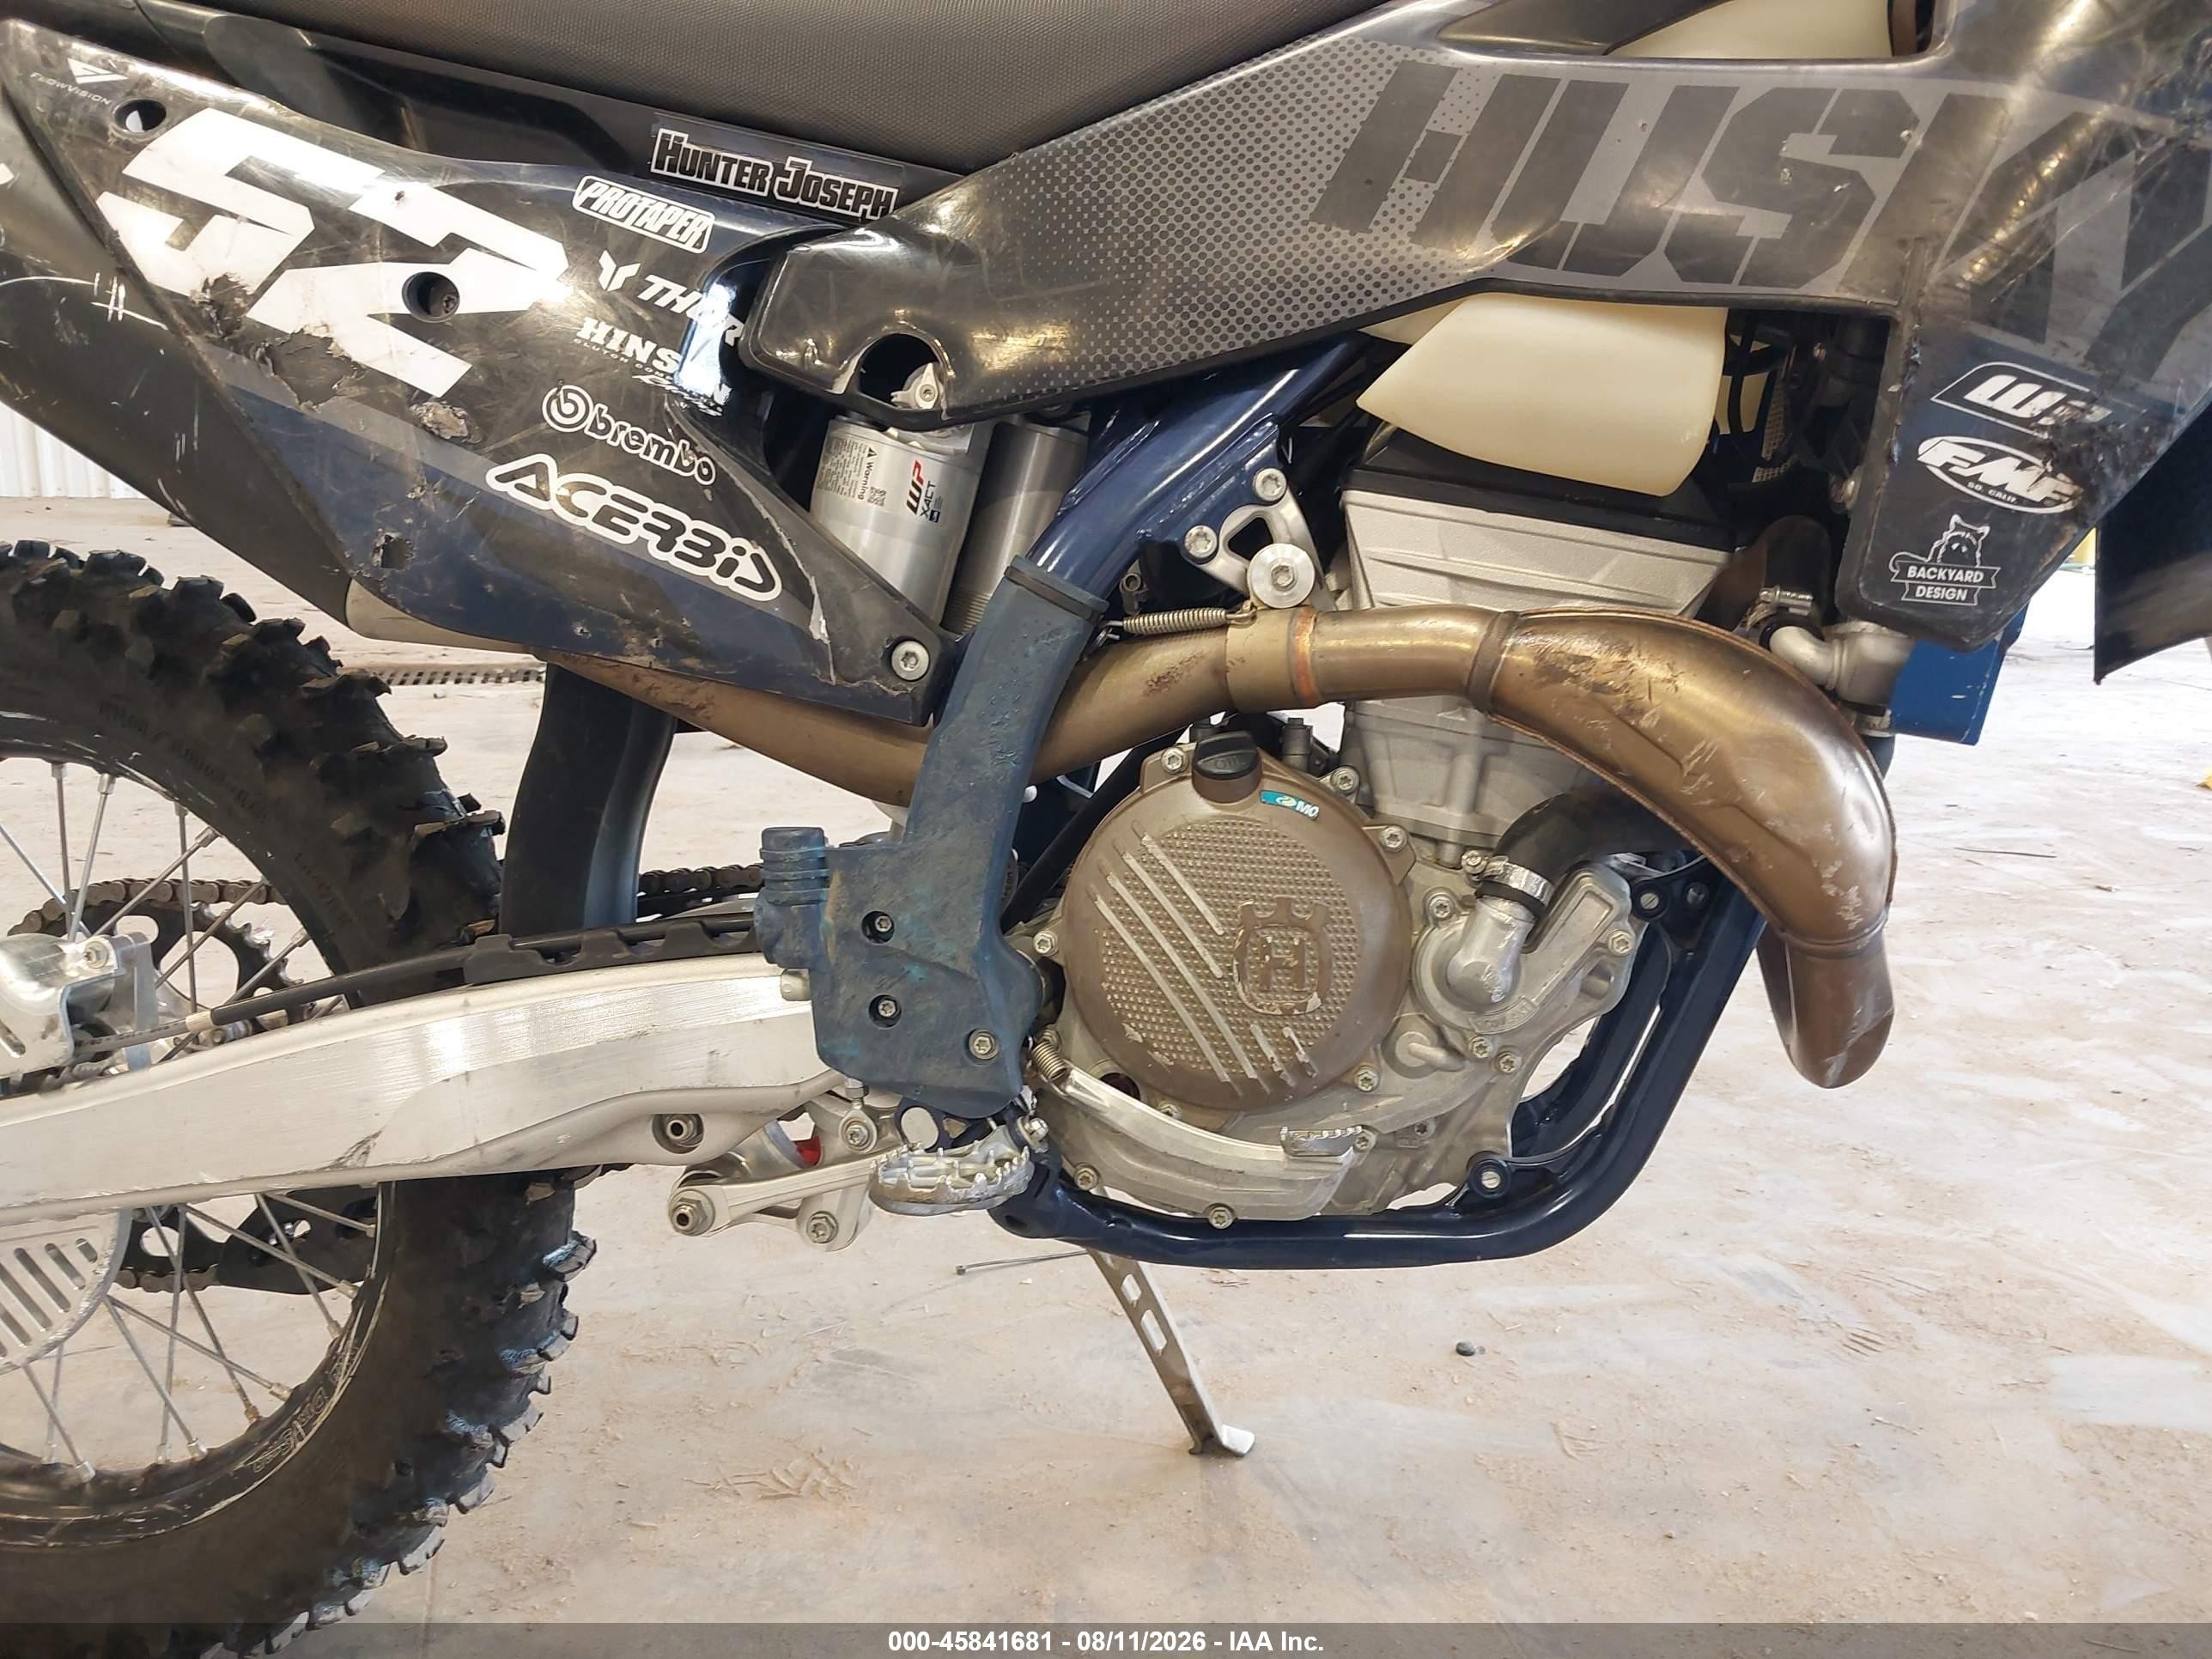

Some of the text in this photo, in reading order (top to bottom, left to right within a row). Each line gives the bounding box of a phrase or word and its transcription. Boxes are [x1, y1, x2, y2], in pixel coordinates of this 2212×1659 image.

[651, 128, 898, 221] HUNTER JOSEPH
[578, 179, 709, 250] PROTAPER
[637, 274, 745, 346] THR
[584, 404, 716, 486] brembo
[857, 461, 874, 501] Warning
[920, 480, 937, 519] XACT
[1906, 566, 1984, 583] BACKYARD
[1915, 586, 1968, 601] DESIGN
